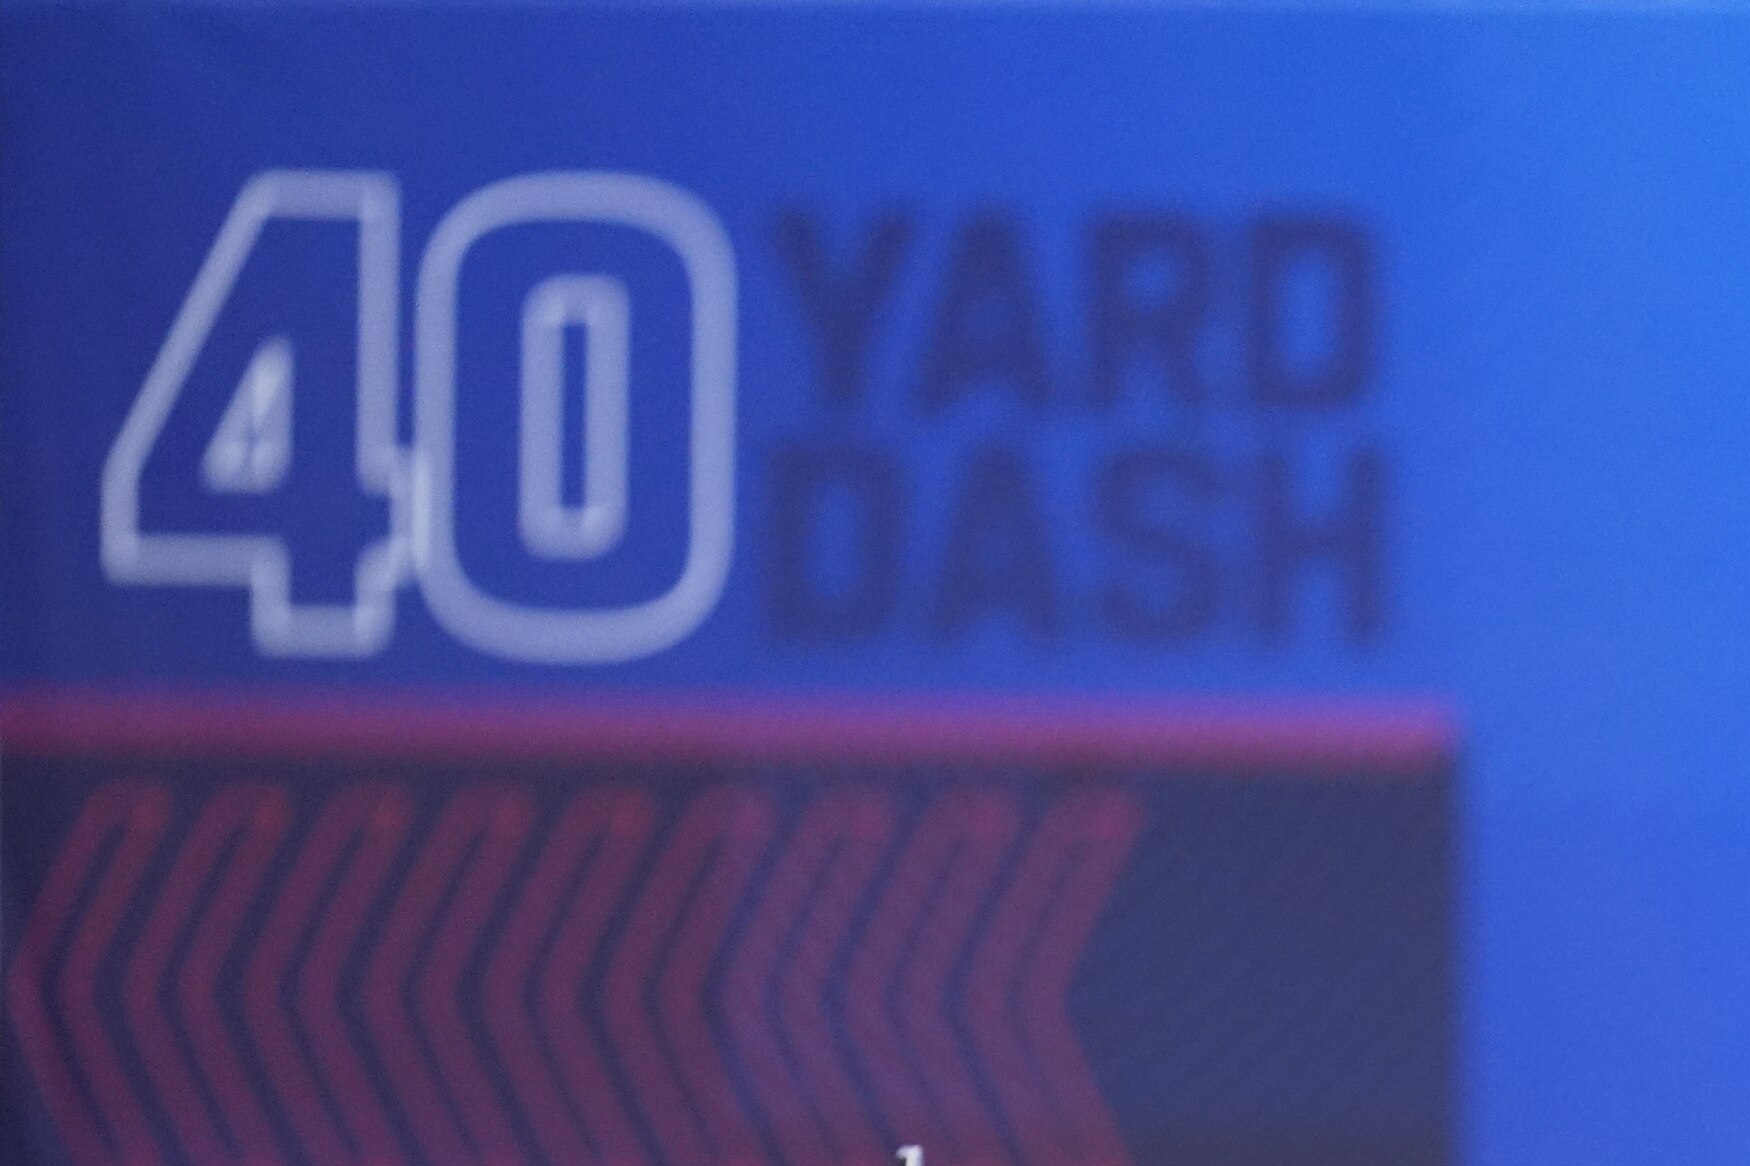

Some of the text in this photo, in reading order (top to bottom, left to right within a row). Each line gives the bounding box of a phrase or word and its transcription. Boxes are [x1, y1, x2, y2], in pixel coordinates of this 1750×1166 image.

[774, 206, 1382, 407] YARD
[101, 169, 738, 665] 40
[766, 448, 1390, 642] DASH
